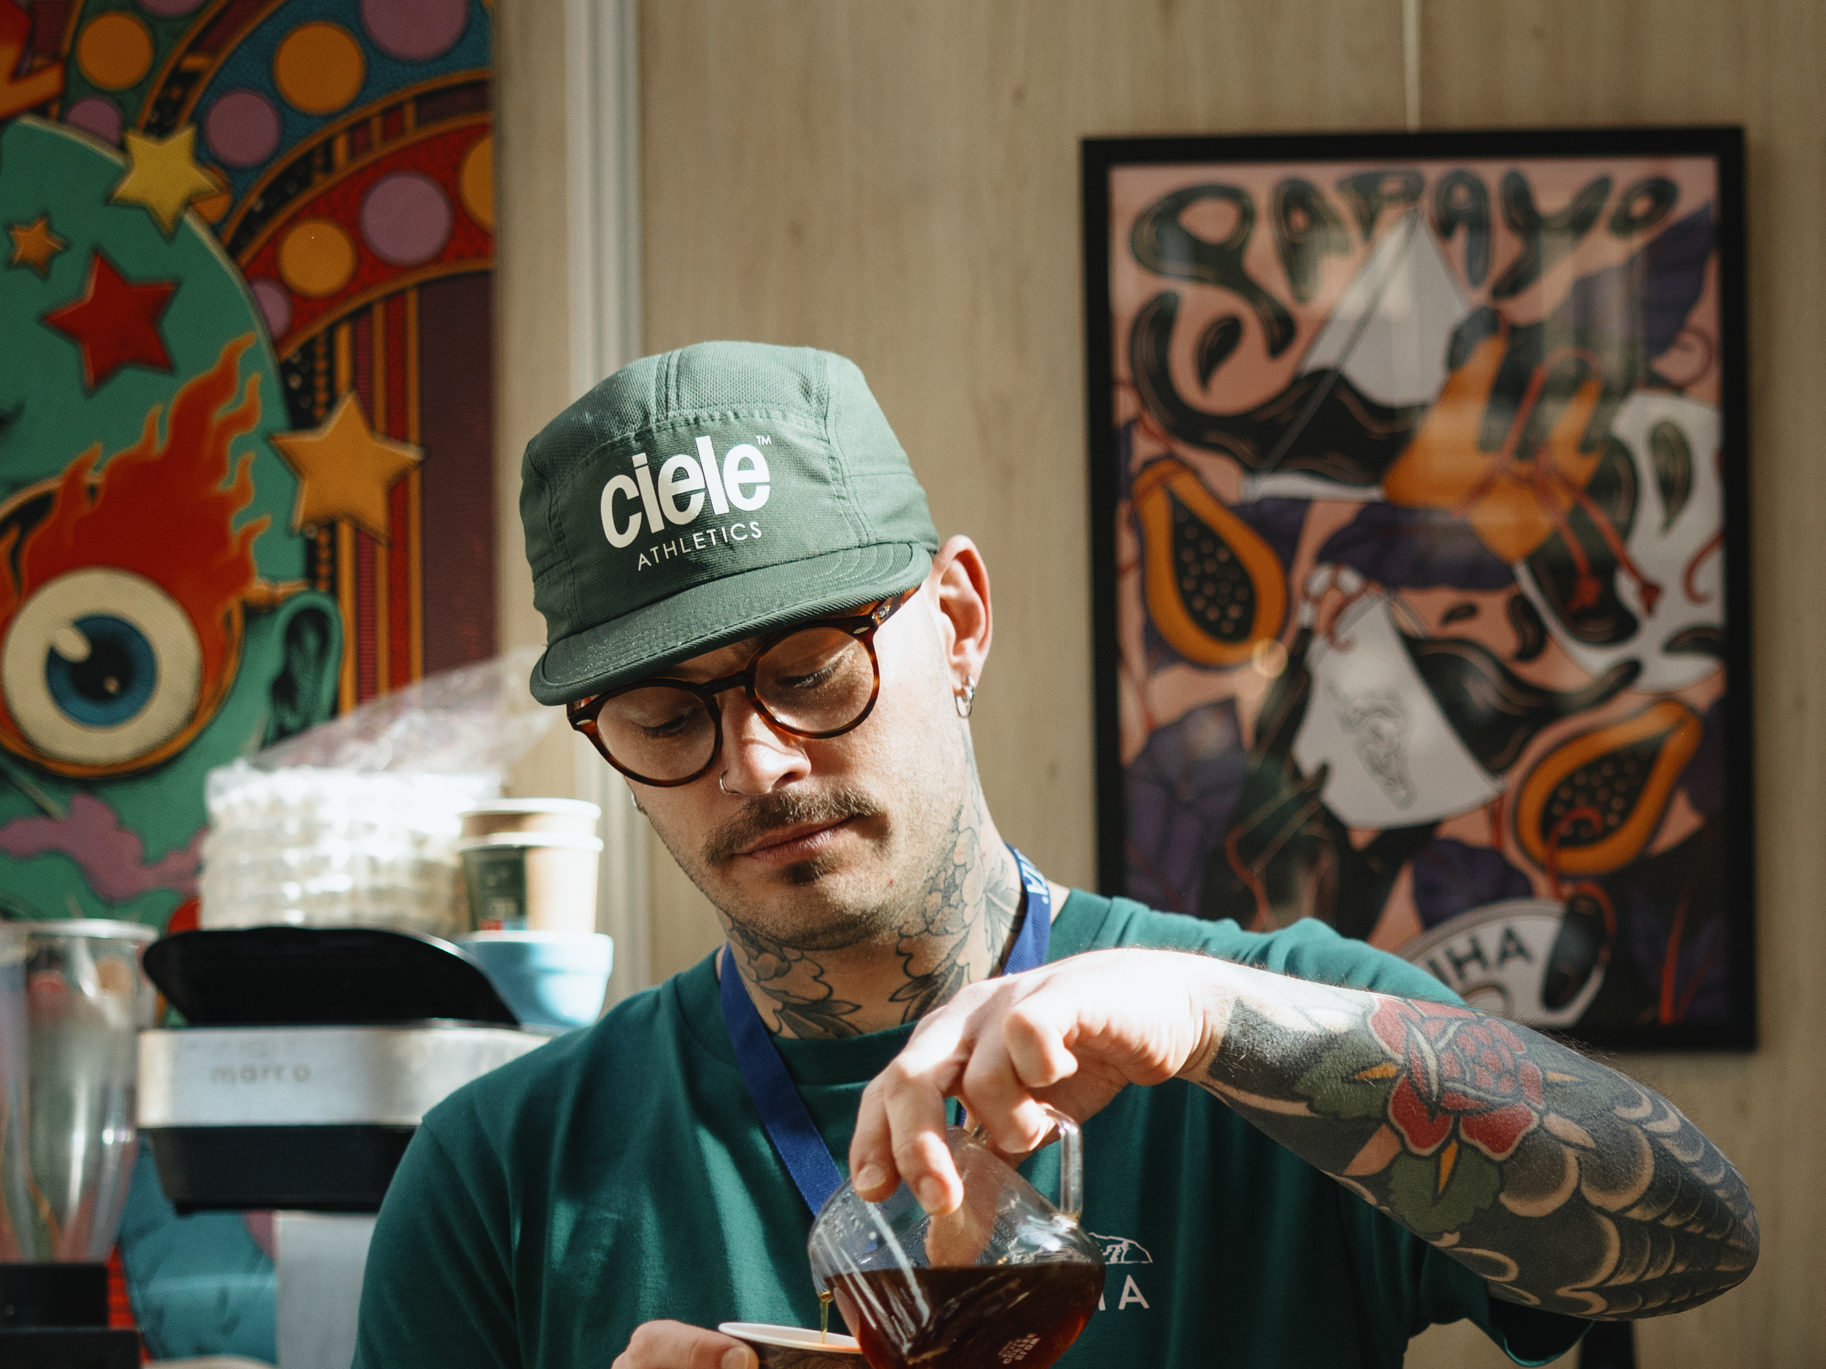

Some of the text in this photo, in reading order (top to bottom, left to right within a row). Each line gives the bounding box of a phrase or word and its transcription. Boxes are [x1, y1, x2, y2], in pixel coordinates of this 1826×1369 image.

[600, 435, 770, 548] ciele
[637, 521, 762, 571] ATHLETICS
[1426, 925, 1536, 985] IHA
